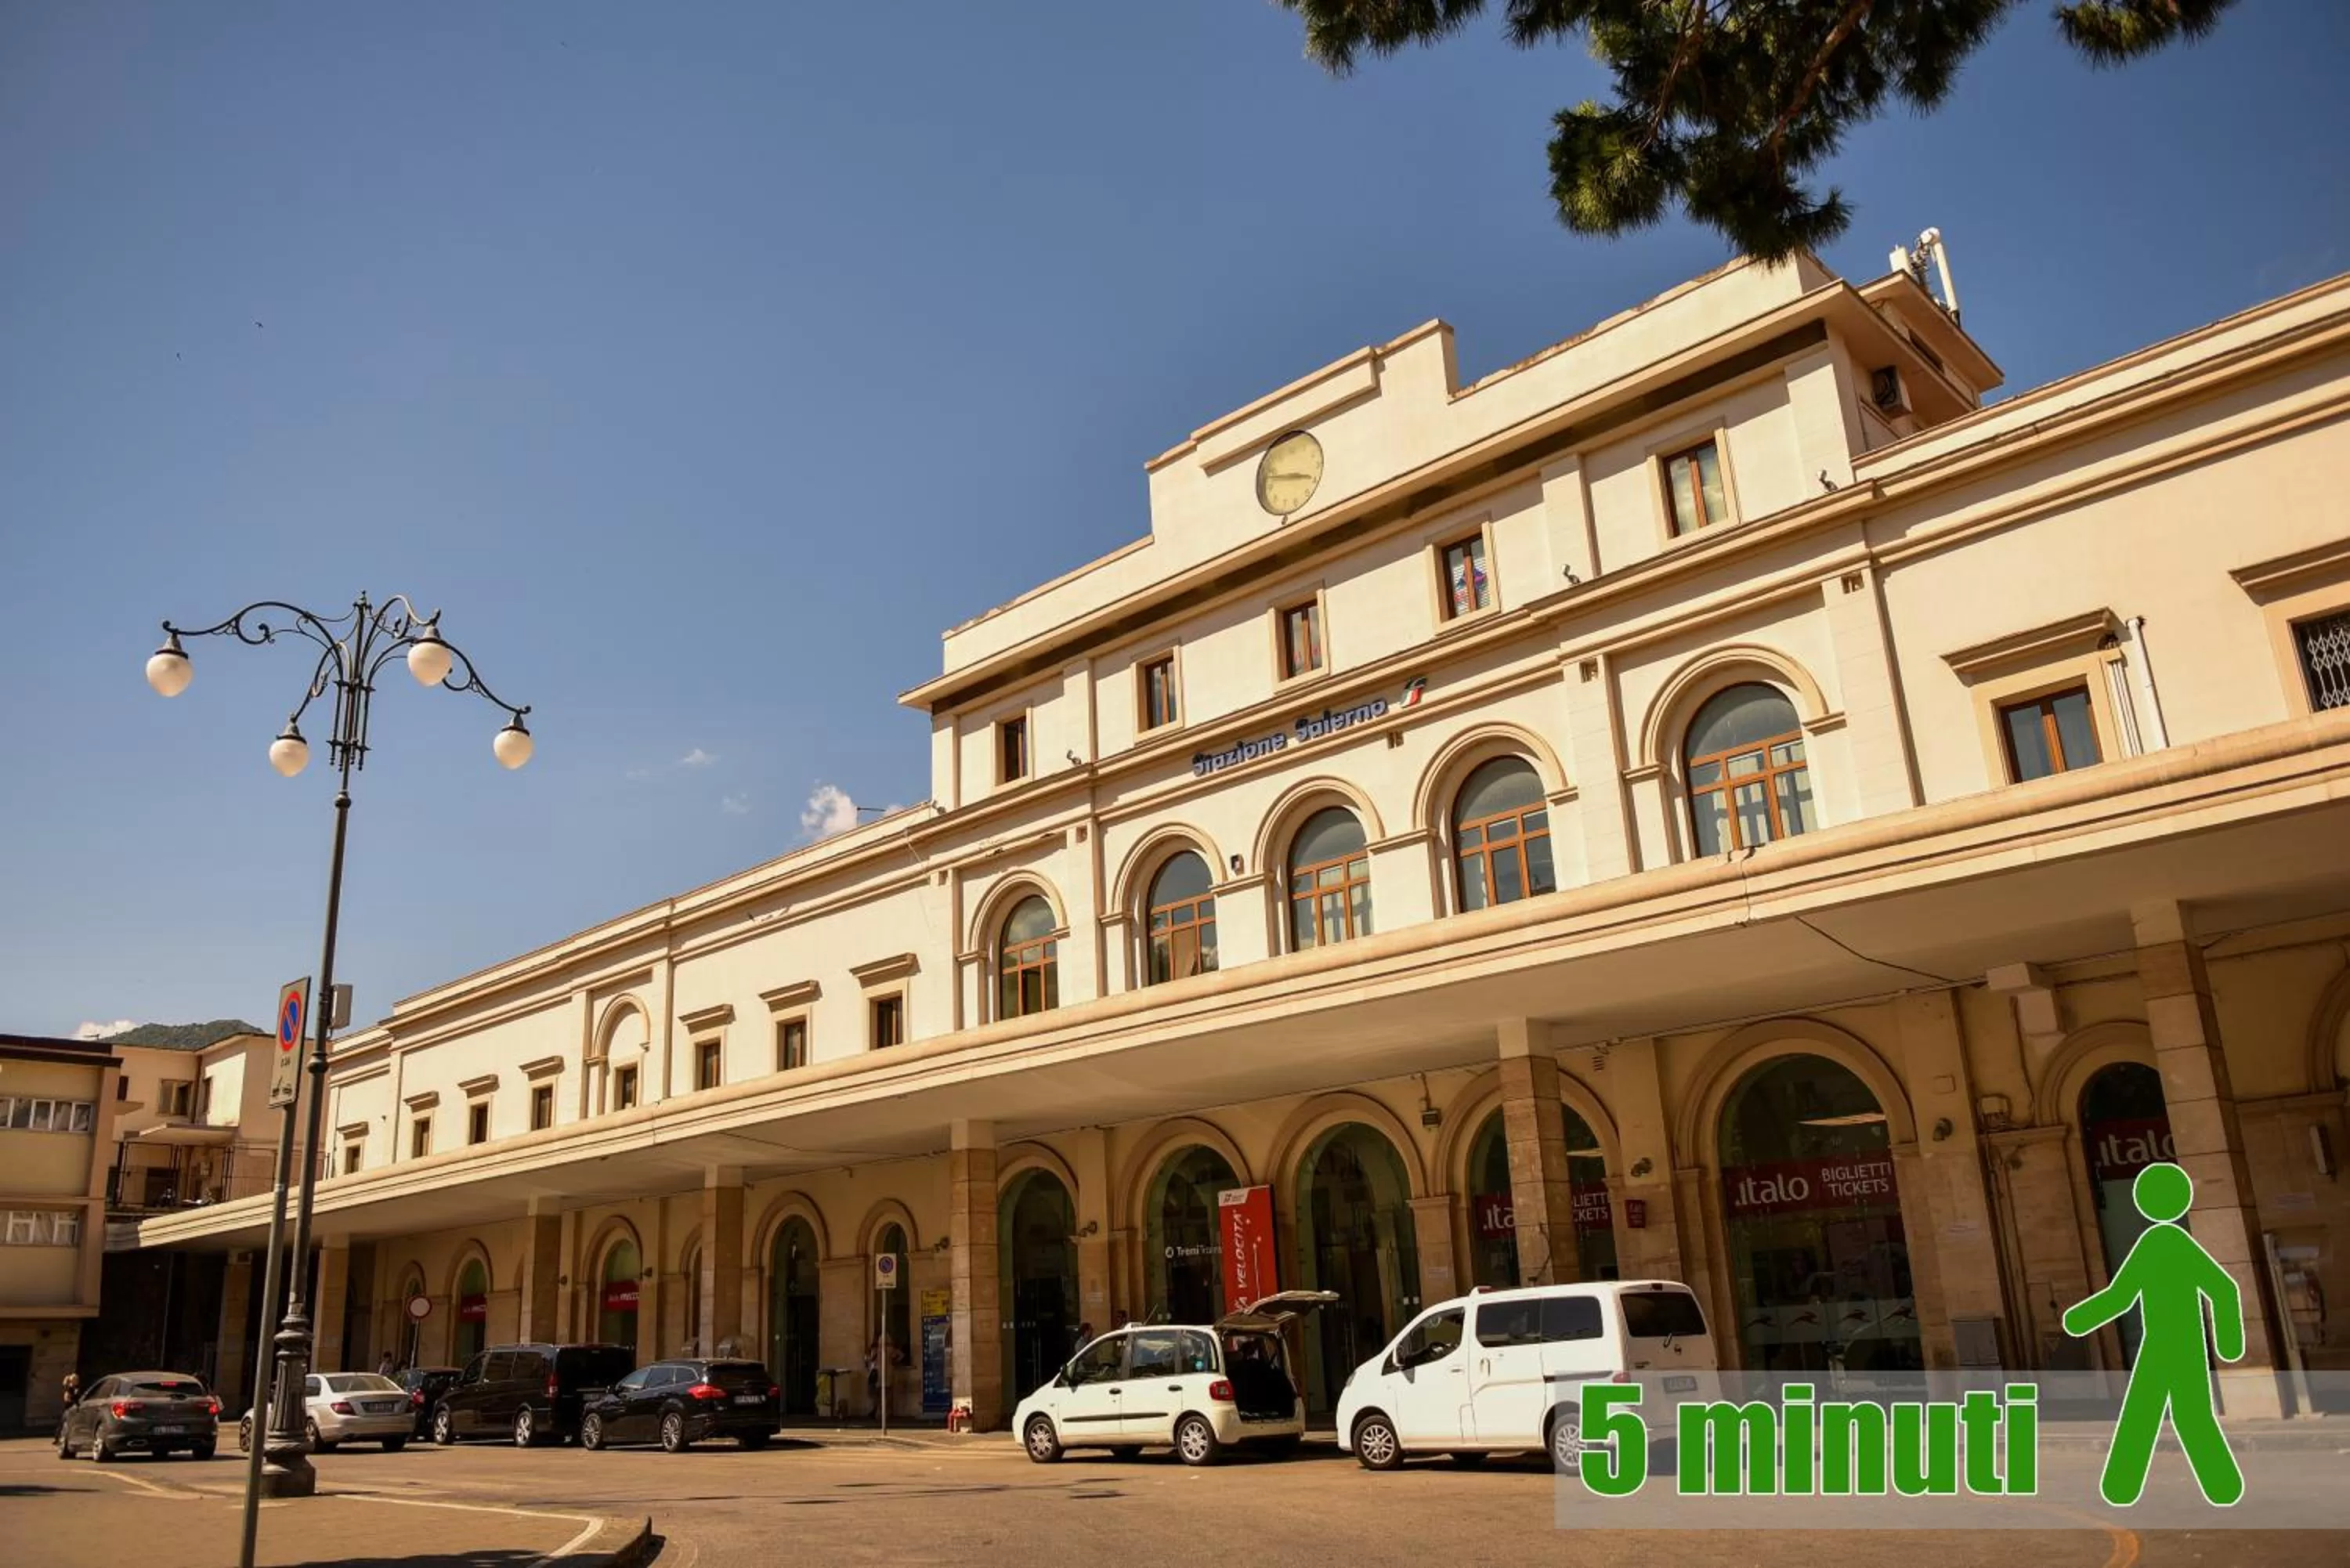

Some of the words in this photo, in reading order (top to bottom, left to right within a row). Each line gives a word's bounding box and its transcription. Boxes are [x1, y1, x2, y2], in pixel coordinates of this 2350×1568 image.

[1191, 732, 1287, 777] Stazione
[1295, 698, 1387, 742] Salerno
[1820, 1162, 1892, 1183] BIGLIETTI
[1828, 1178, 1890, 1198] TICKETS
